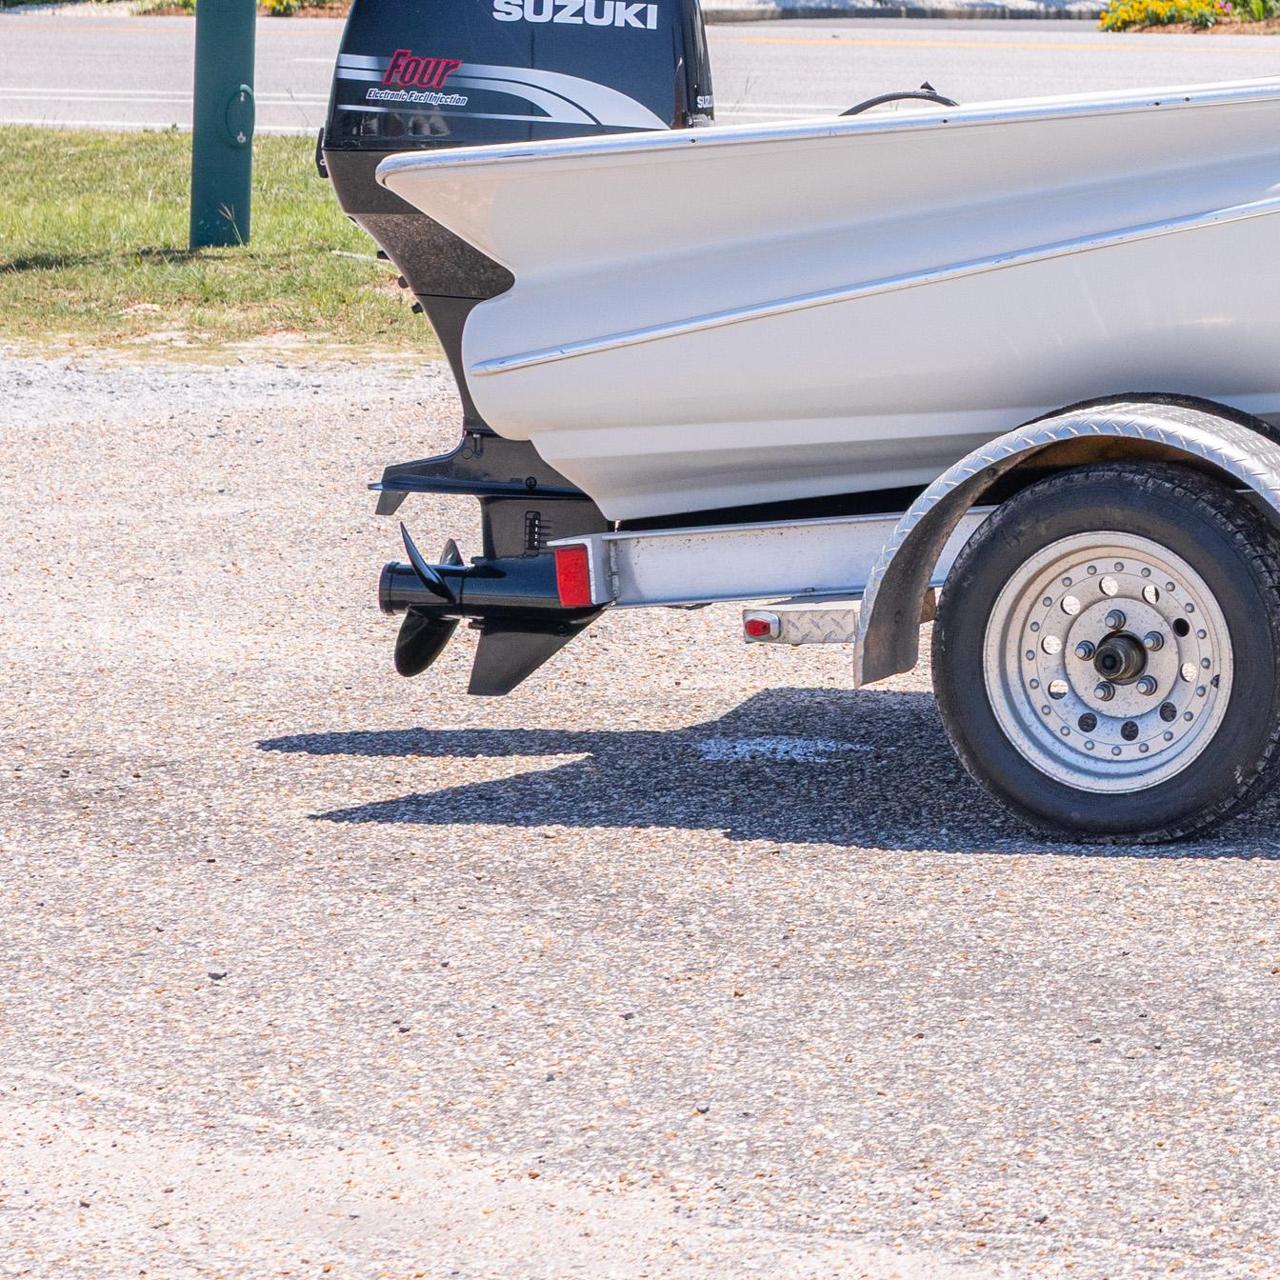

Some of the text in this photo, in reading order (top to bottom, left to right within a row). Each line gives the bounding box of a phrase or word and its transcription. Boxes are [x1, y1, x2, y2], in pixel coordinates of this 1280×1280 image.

[366, 88, 469, 106] Electronic Fuel Injection
